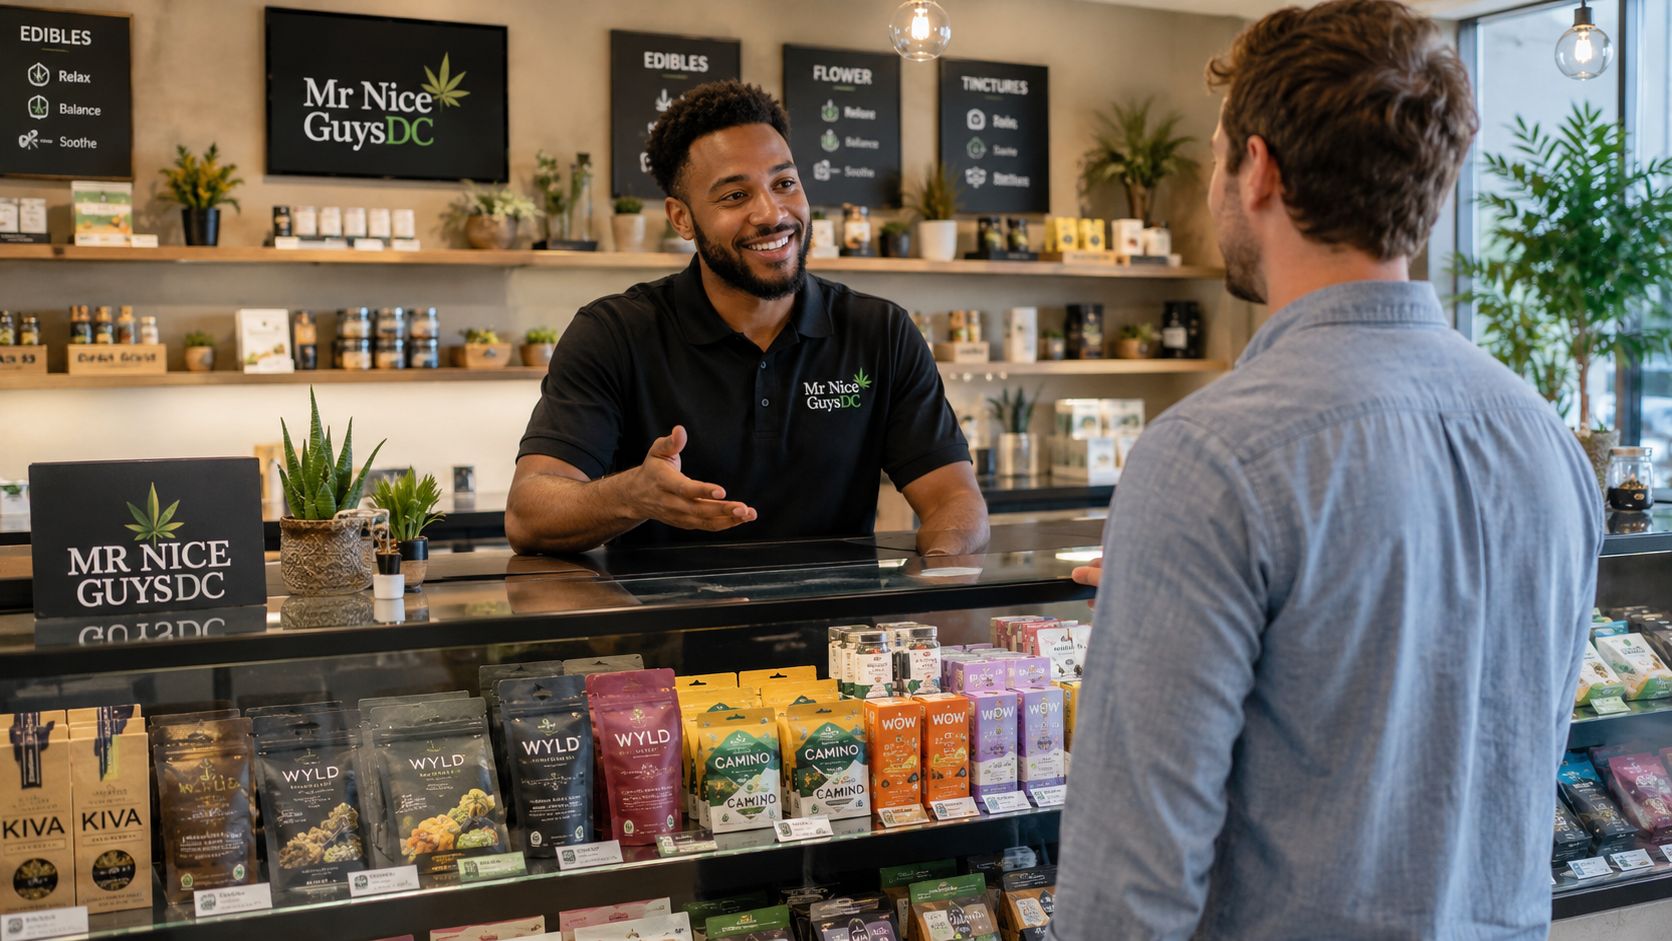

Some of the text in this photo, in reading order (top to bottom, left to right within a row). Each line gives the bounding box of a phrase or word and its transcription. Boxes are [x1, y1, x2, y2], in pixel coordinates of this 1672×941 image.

[20, 25, 92, 46] EDIBLES
[643, 51, 709, 73] EDIBLES
[58, 70, 91, 83] Relax
[812, 64, 873, 85] FLOWER
[960, 75, 1029, 95] TINCTURES
[303, 77, 433, 113] Mr Nice
[59, 103, 101, 116] Balance
[303, 111, 434, 151] GuysDC
[59, 136, 97, 148] Soothe
[803, 380, 860, 396] Mr Nice
[806, 394, 861, 412] GuysDC
[67, 540, 231, 576] MR NICE
[76, 572, 225, 607] GUYSDC
[981, 706, 1014, 720] WOW
[1028, 701, 1061, 715] WOW
[881, 715, 917, 730] WOW
[932, 711, 966, 725] WOW
[521, 736, 580, 756] WYLD
[614, 729, 671, 748] WYLD
[714, 752, 771, 769] CAMINO
[804, 744, 859, 761] CAMINO
[408, 754, 465, 770] WYLD
[281, 766, 340, 783] WYLD
[2, 816, 66, 840] KIVA
[82, 807, 143, 832] KIVA
